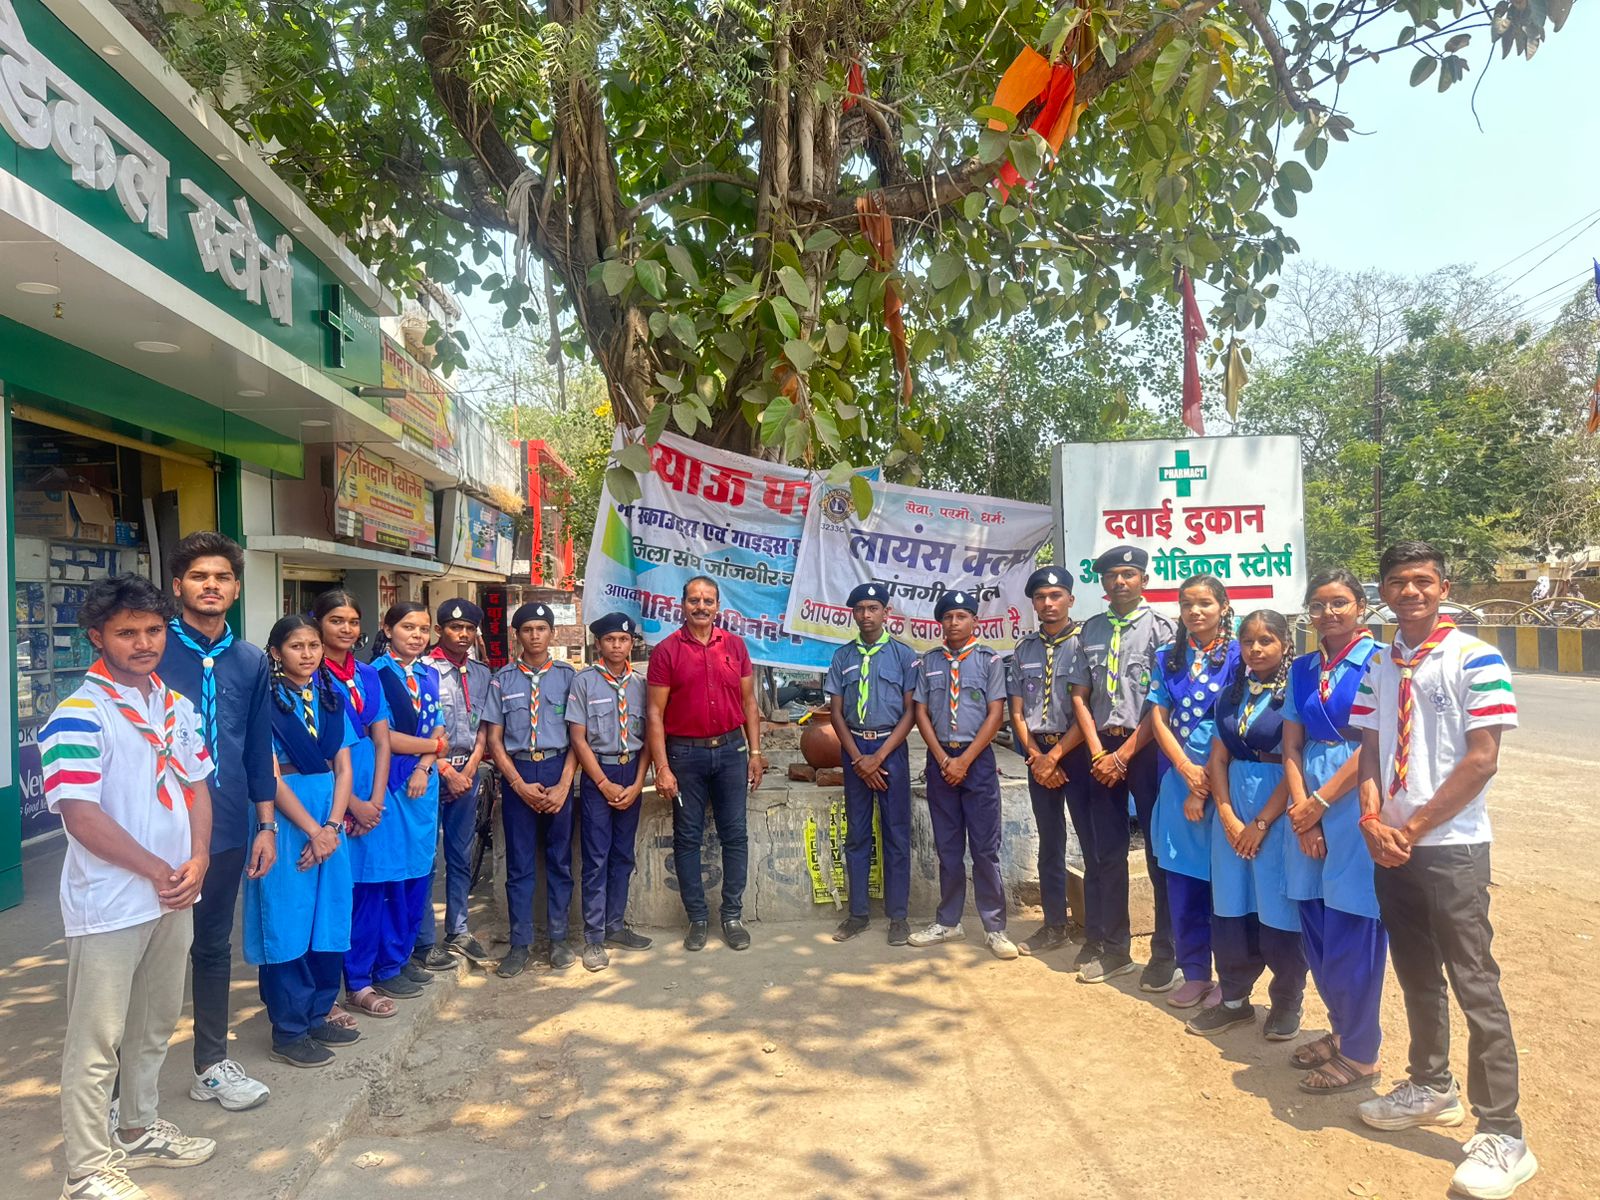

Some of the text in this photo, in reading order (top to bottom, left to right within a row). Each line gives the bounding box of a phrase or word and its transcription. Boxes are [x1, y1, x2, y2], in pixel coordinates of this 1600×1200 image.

[181, 178, 294, 328] स्टोर्स
[357, 447, 388, 486] निदान
[1164, 467, 1205, 480] PHARMACY
[702, 522, 731, 545] एवं
[731, 529, 789, 558] गाइड्स
[1103, 498, 1266, 545] दवाई दुकान
[632, 535, 671, 563] जिला
[673, 547, 702, 571] संघ
[703, 557, 781, 586] जांजगीर
[850, 524, 955, 574] लायंस
[1151, 543, 1293, 580] मेडिकल स्टोर्स
[800, 599, 854, 628] आपका
